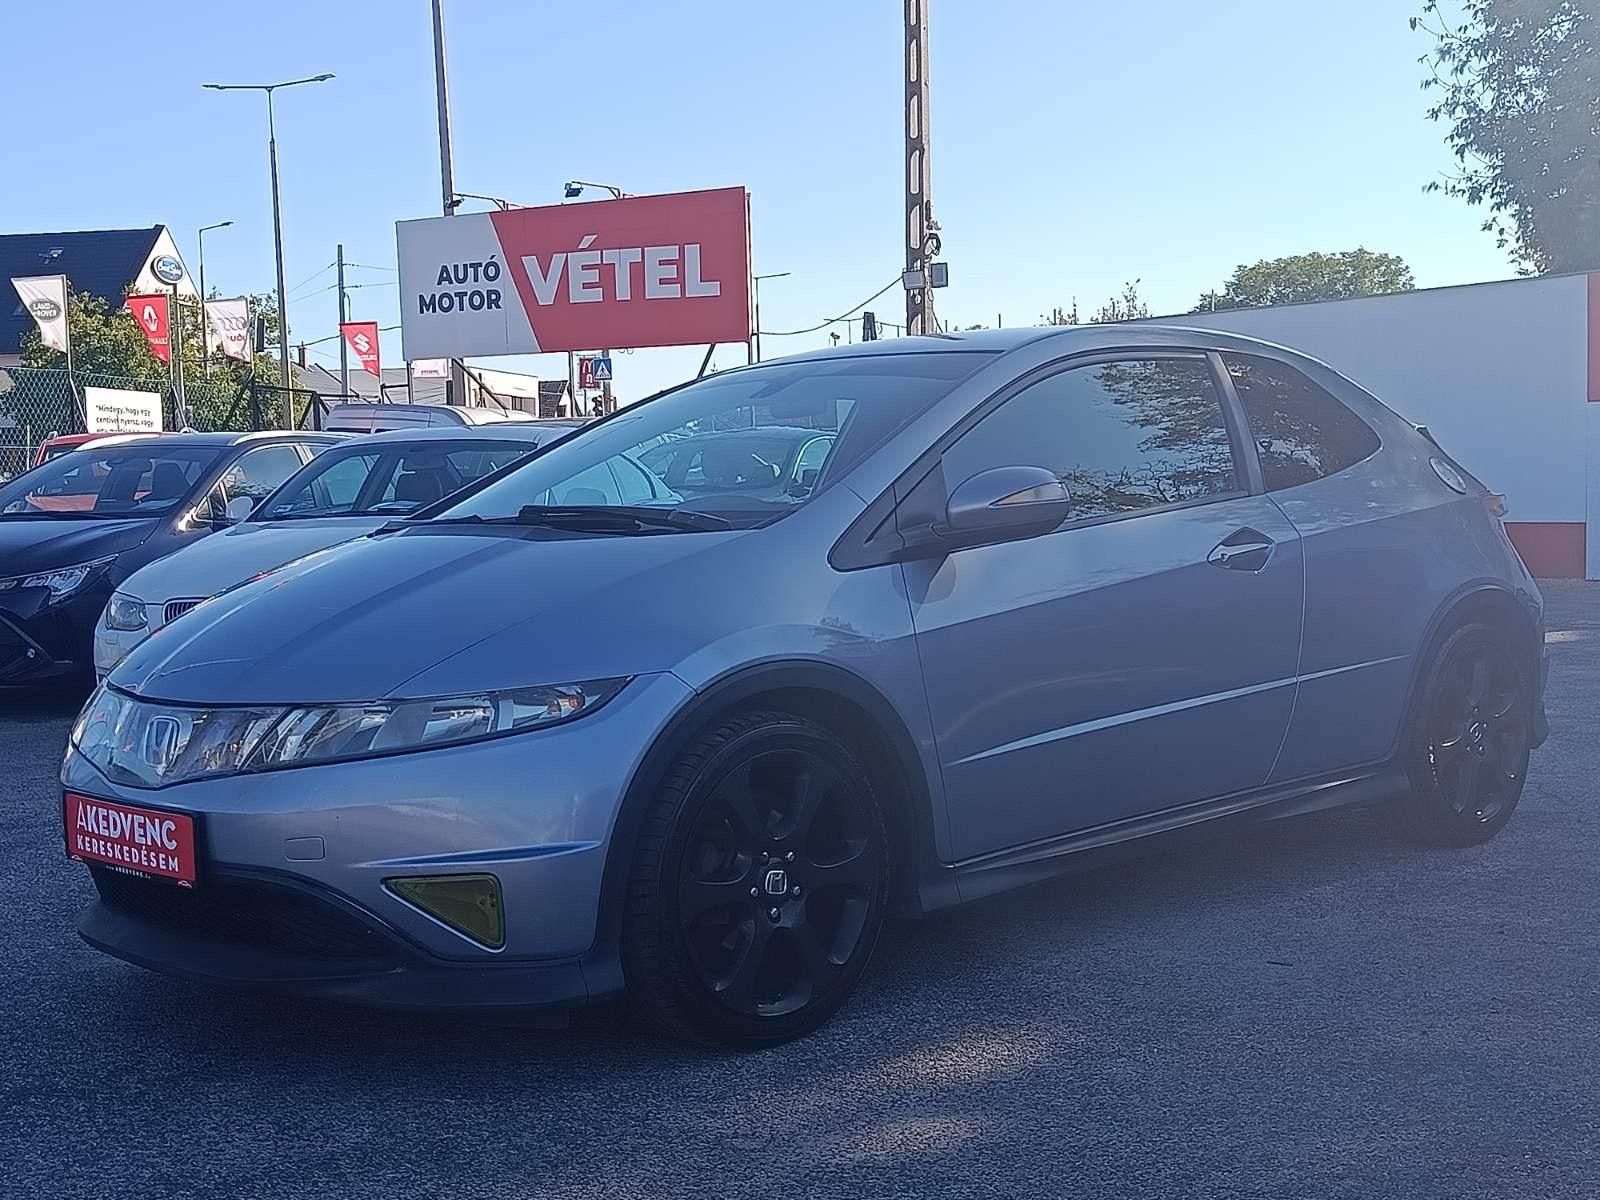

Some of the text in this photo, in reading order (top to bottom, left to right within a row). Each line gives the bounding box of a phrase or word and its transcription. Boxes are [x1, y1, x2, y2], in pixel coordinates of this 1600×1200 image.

[437, 254, 501, 286] AUTÓ
[521, 234, 721, 306] VÉTEL
[418, 288, 502, 315] MOTOR
[76, 834, 180, 873] KERESKEDÉSEM
